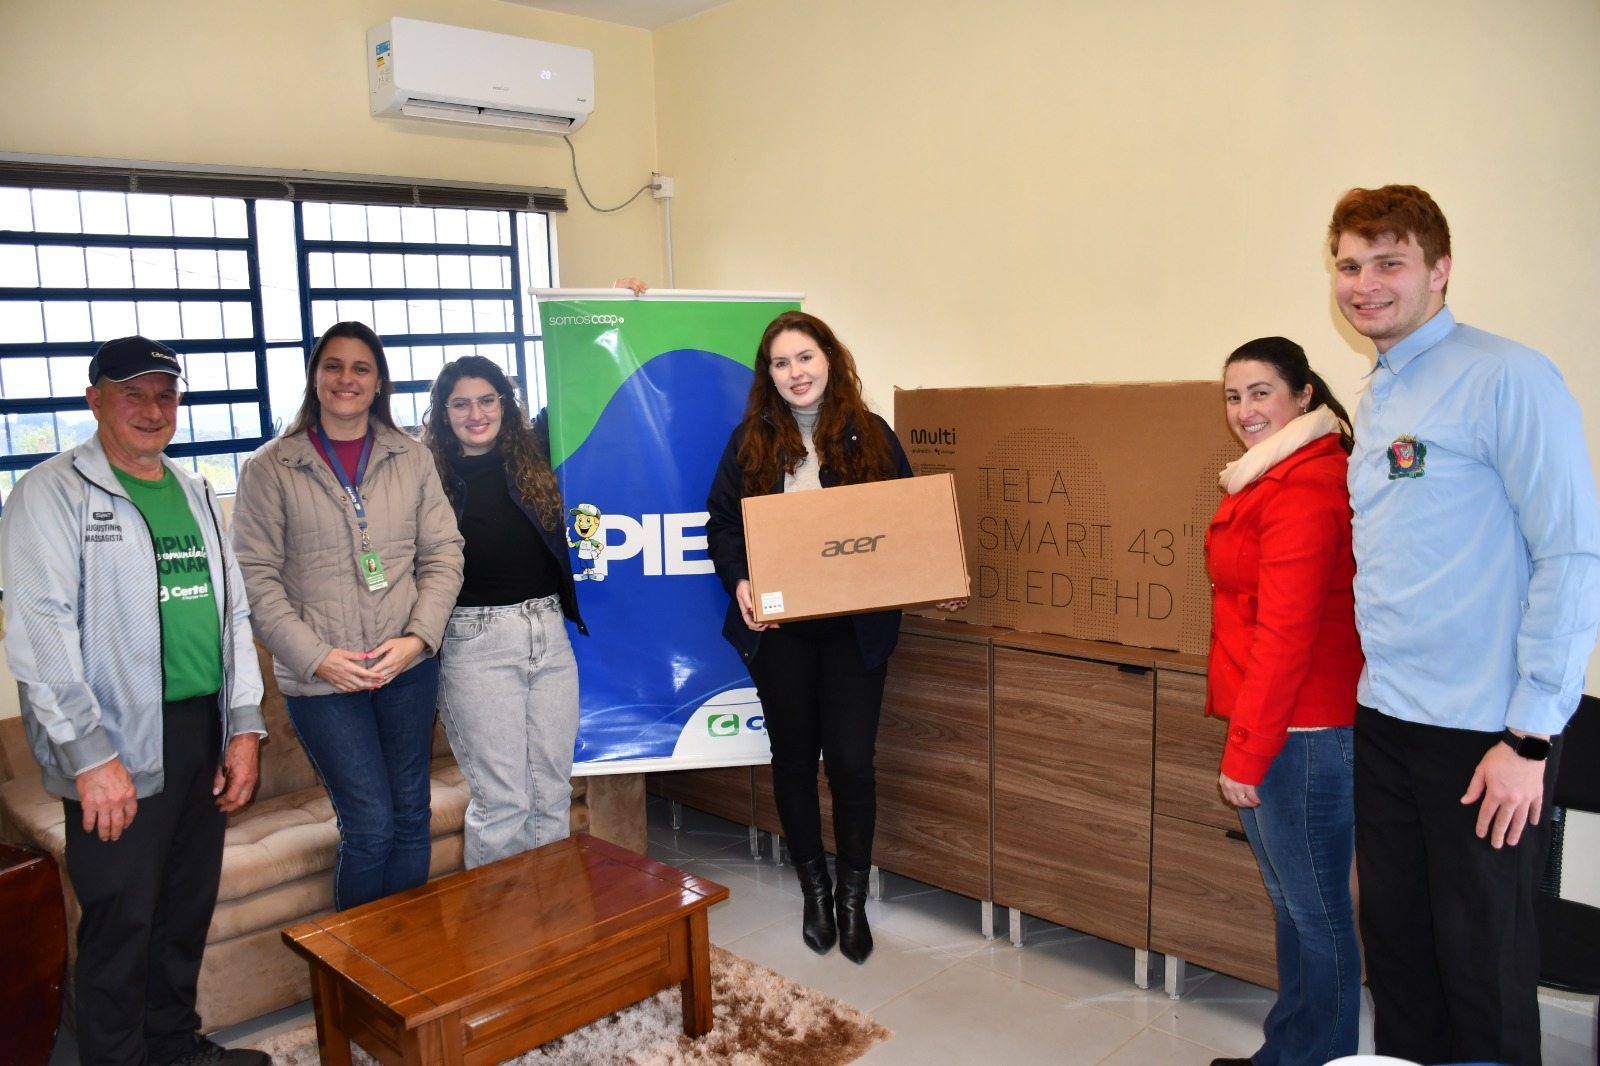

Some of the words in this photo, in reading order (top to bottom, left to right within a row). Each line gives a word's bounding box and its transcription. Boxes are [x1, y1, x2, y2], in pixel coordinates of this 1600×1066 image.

[540, 70, 551, 80] 28
[911, 428, 956, 445] Multi
[978, 467, 1071, 506] TELA
[85, 534, 123, 542] MASSAGISTA
[594, 511, 716, 576] PIE
[821, 534, 886, 558] acer
[979, 516, 1112, 560] SMART
[171, 583, 208, 597] Certel
[979, 565, 1074, 608] DLED
[1090, 577, 1173, 620] FHD
